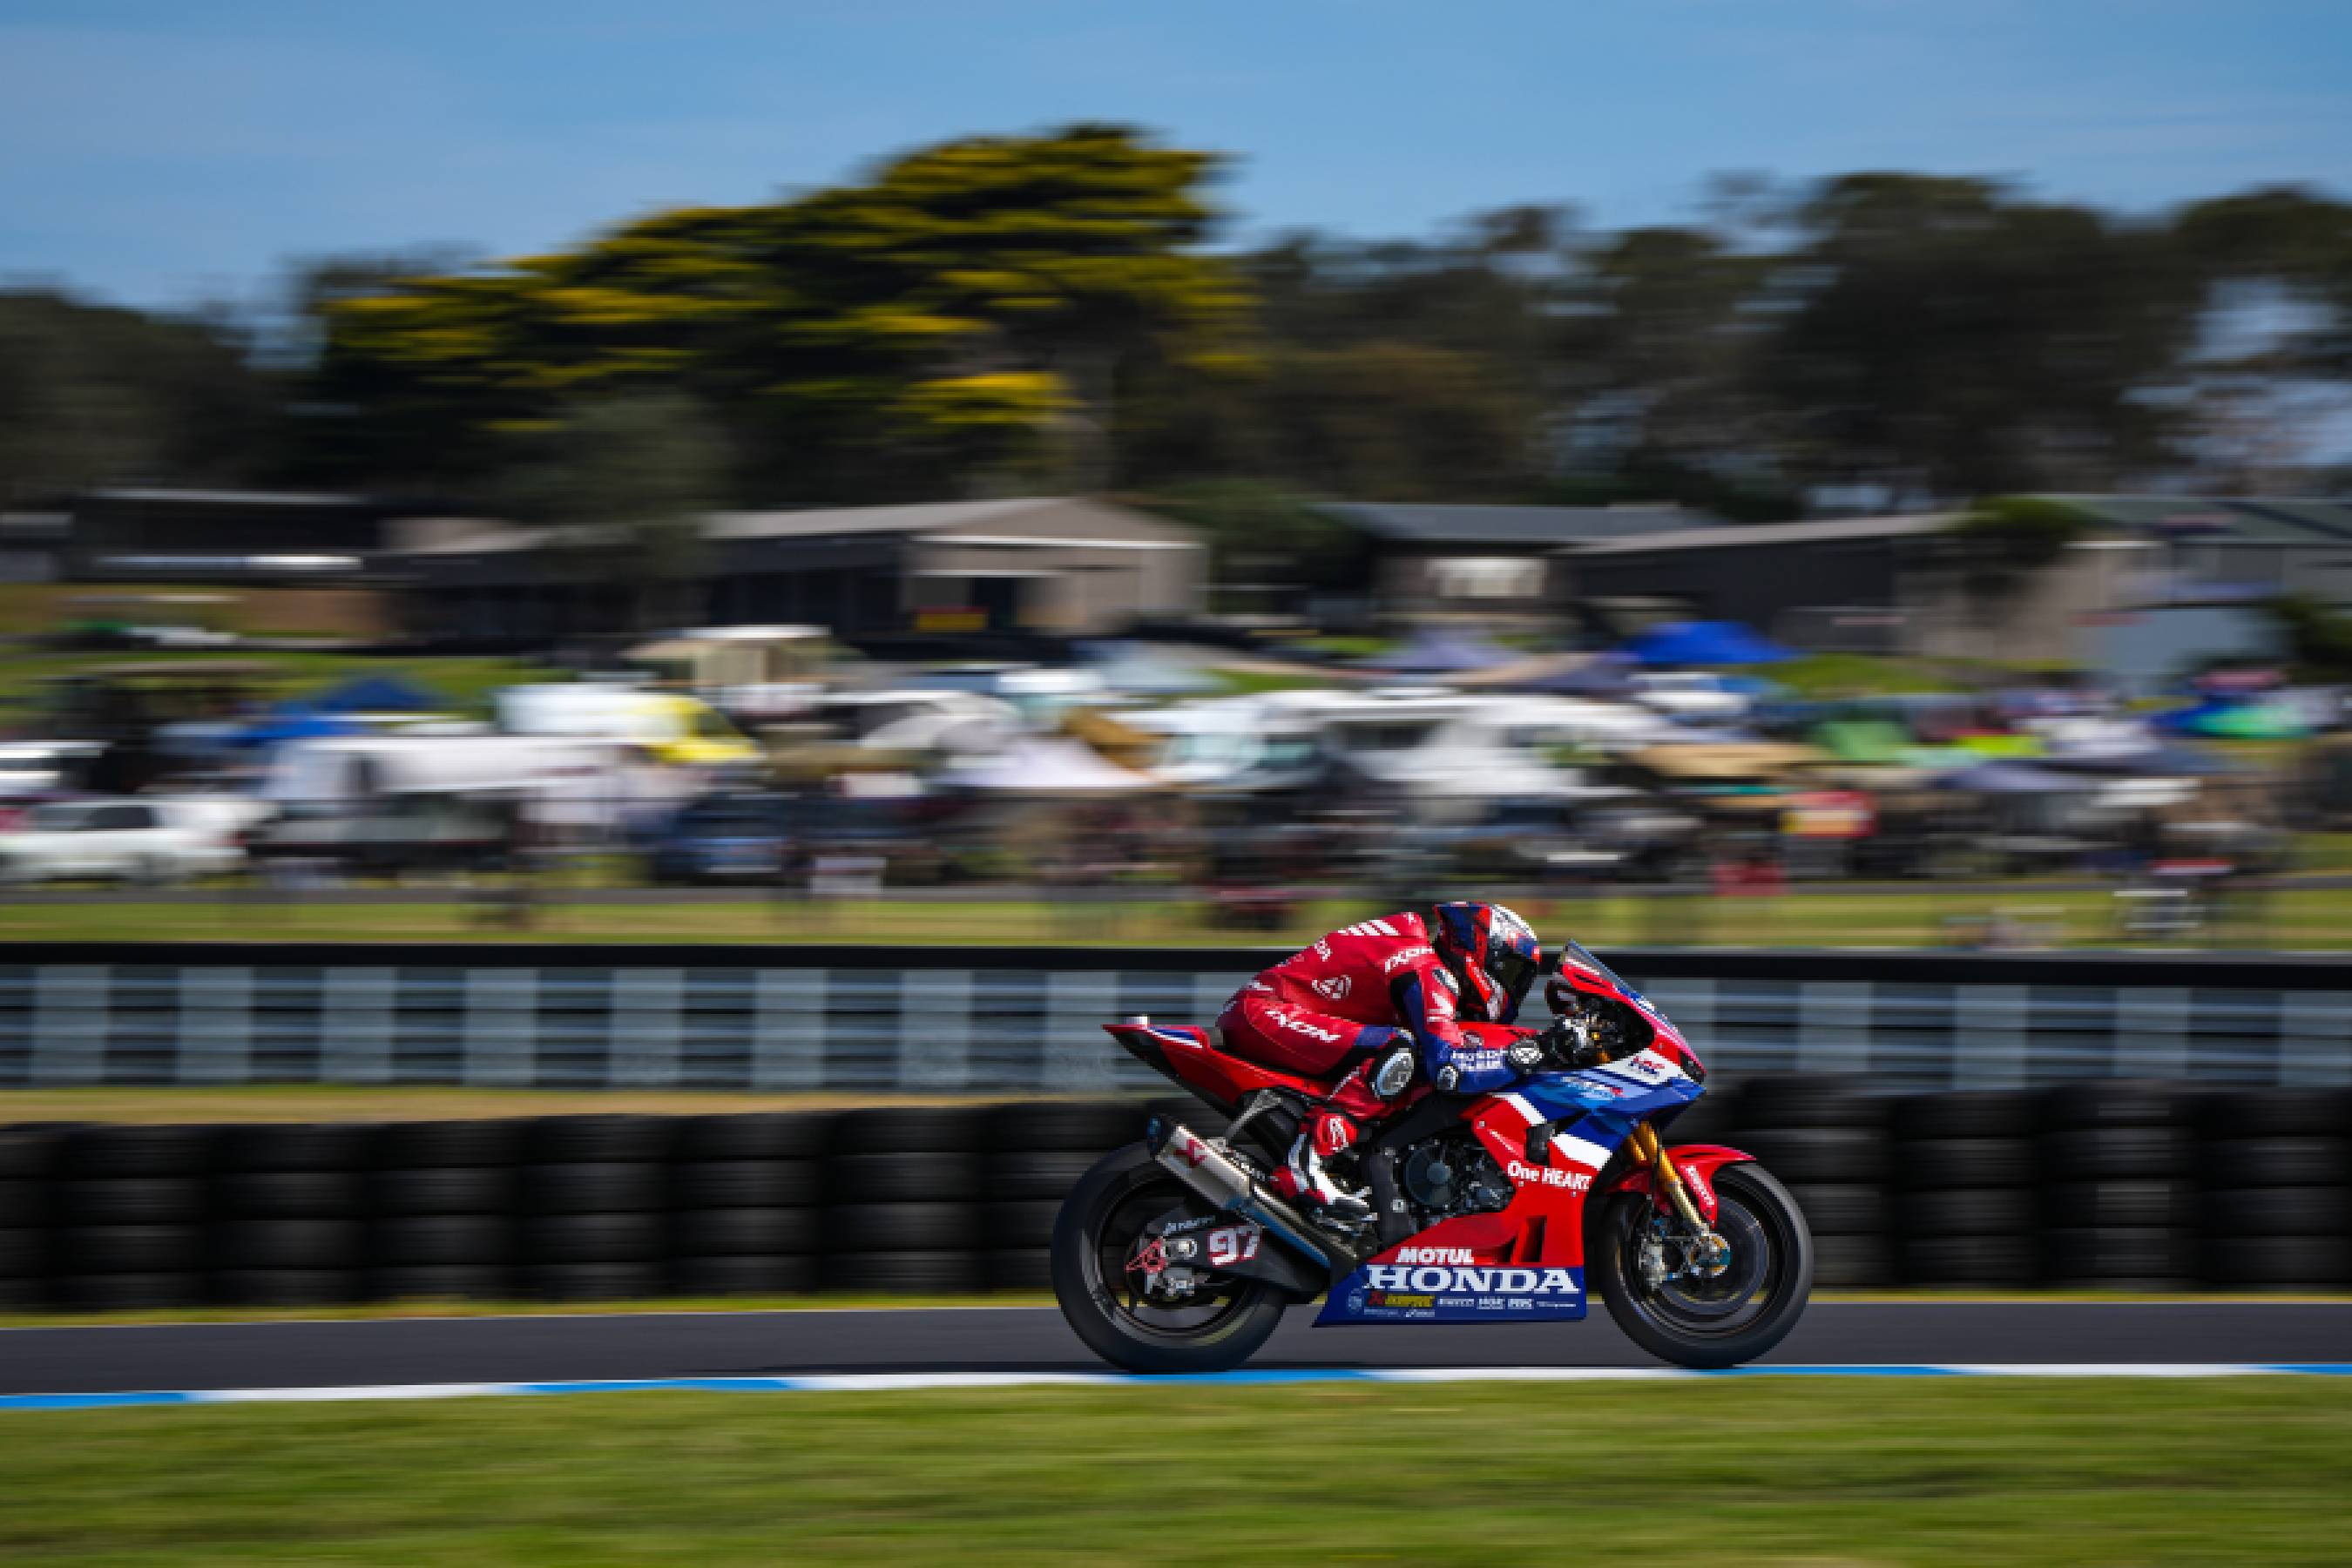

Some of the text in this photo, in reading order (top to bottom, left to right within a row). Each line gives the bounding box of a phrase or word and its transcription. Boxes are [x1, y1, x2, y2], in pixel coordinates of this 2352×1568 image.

[1507, 1160, 1592, 1190] One HEART
[1207, 1224, 1262, 1267] 97
[1396, 1247, 1475, 1265] MOTUL
[1362, 1265, 1581, 1294] HONDA
